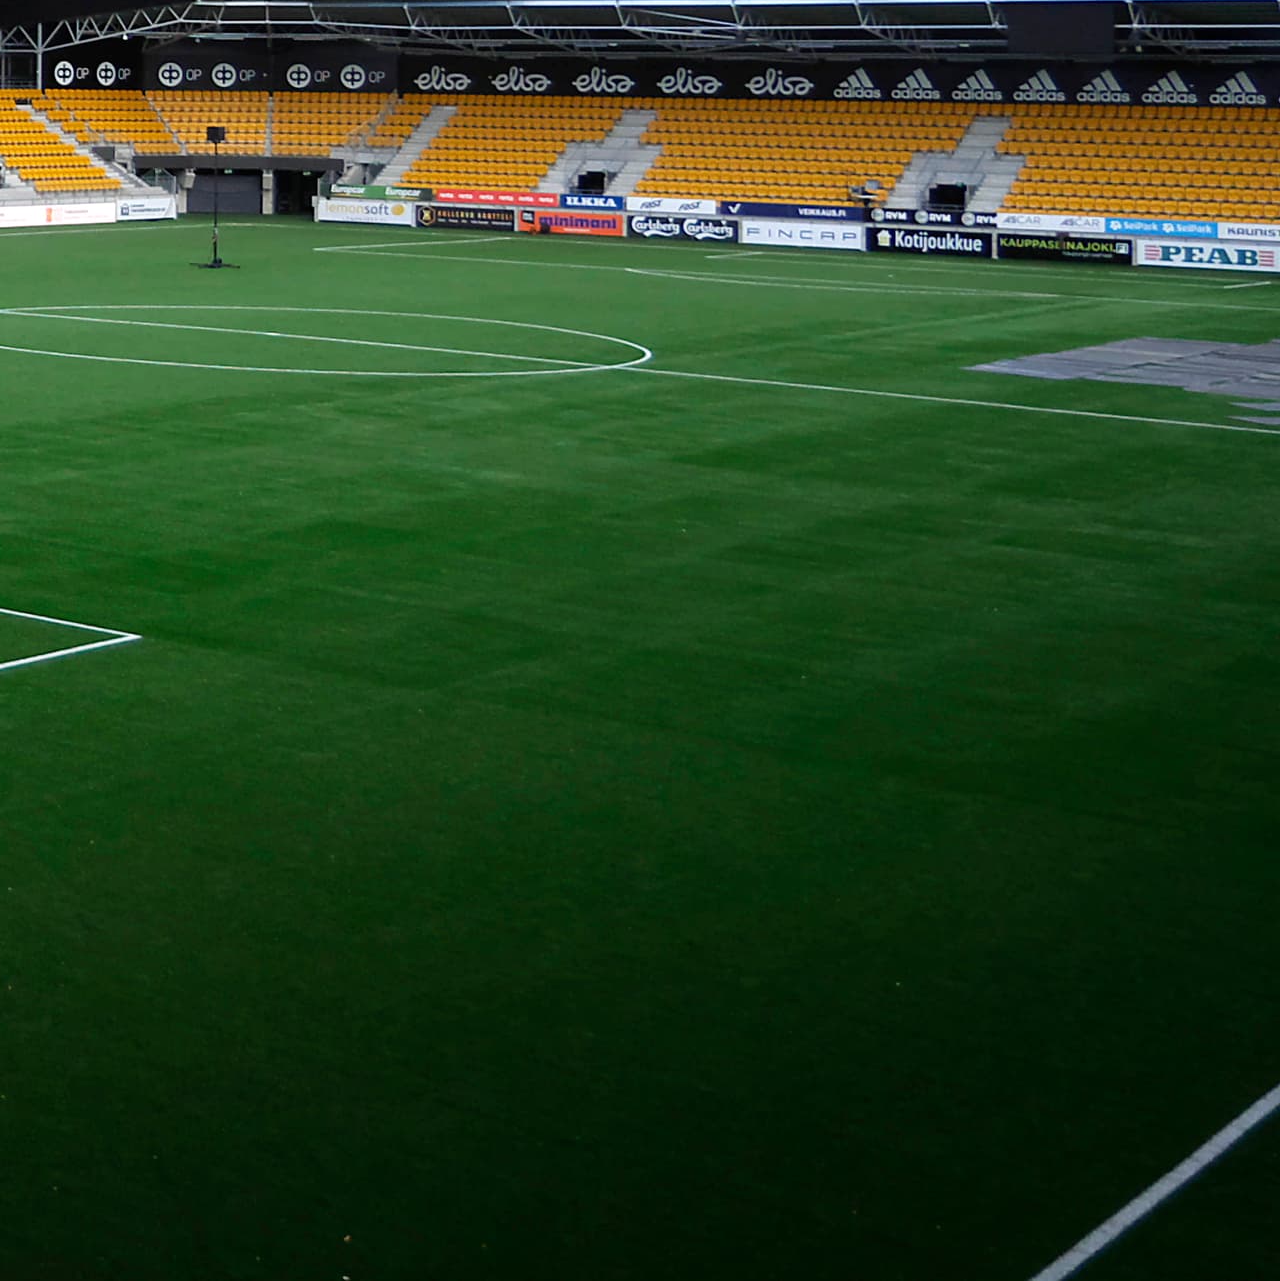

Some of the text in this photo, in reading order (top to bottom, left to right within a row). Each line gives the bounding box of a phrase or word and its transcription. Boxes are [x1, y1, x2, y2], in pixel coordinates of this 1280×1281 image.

[75, 67, 90, 79] OP
[117, 68, 131, 80] OP
[185, 69, 202, 80] OP
[239, 69, 256, 81] OP
[314, 70, 331, 82] OP
[368, 71, 385, 83] OP
[413, 66, 471, 90] elisa
[491, 66, 552, 91] elisa
[571, 67, 635, 92] elisa
[656, 67, 723, 94] elisa
[744, 68, 814, 96] elisa
[833, 86, 881, 99] adidas
[891, 87, 940, 100] adidas
[951, 88, 1003, 101] adidas
[1012, 88, 1066, 102] adidas
[1076, 89, 1130, 103] adidas
[1141, 90, 1198, 104] adidas
[1209, 90, 1267, 105] adidas
[566, 196, 617, 208] ILKKA
[798, 208, 847, 217] VEIKKAUS.FI
[885, 211, 907, 221] RVM
[928, 213, 951, 223] RVM
[631, 216, 680, 235] Carlsberg
[683, 218, 734, 238] Carlsberg
[746, 227, 857, 241] FINCAP
[894, 230, 983, 253] Kotijoukkue
[1159, 245, 1259, 266] PEAB
